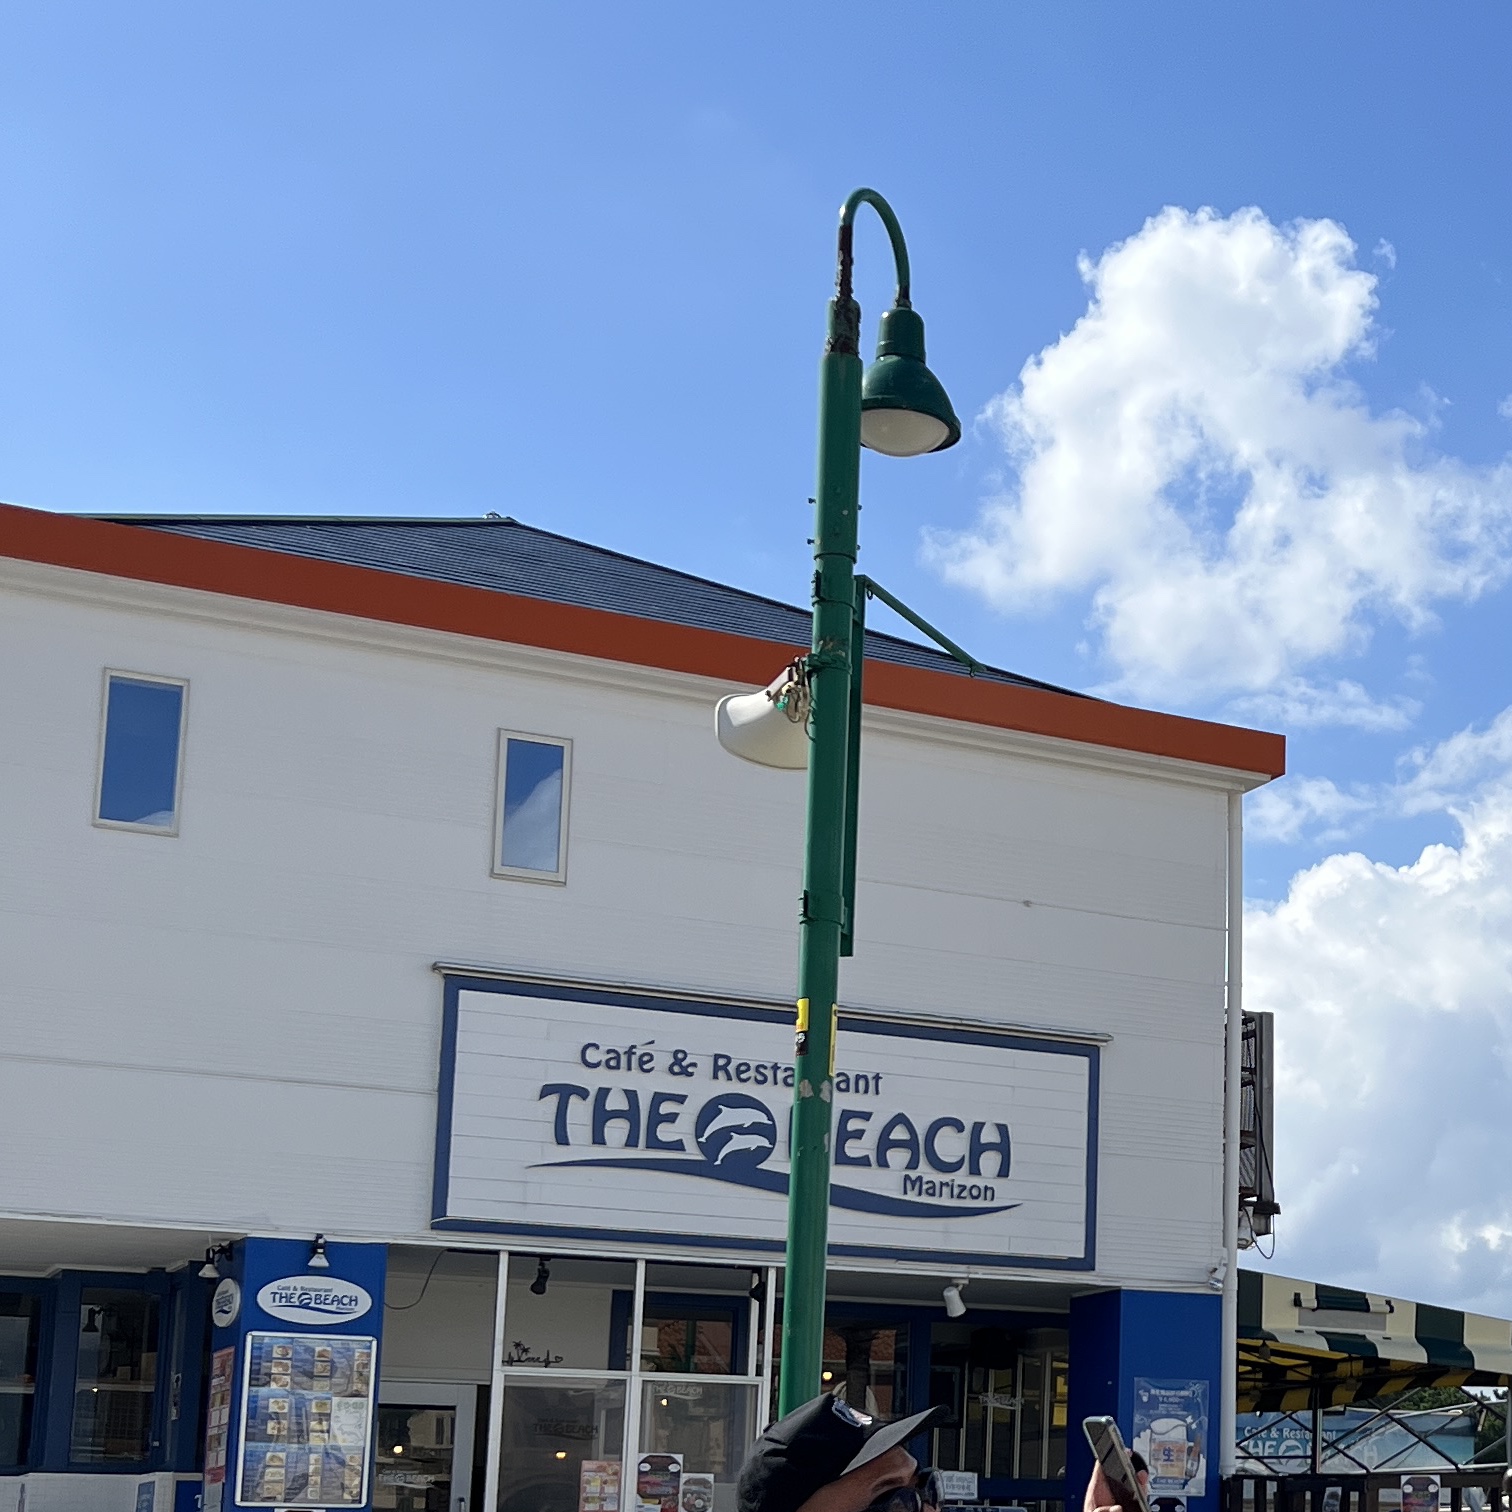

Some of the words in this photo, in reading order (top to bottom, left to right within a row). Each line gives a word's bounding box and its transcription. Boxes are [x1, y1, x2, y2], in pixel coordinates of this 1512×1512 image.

[581, 1040, 656, 1073] Café
[669, 1049, 698, 1077] &
[713, 1053, 883, 1095] Restaant
[539, 1083, 688, 1151] THE
[789, 1104, 1012, 1178] EACH
[903, 1174, 995, 1201] Marizon
[270, 1292, 297, 1304] THE
[314, 1294, 358, 1307] BEACH
[1283, 1428, 1337, 1441] Restaant
